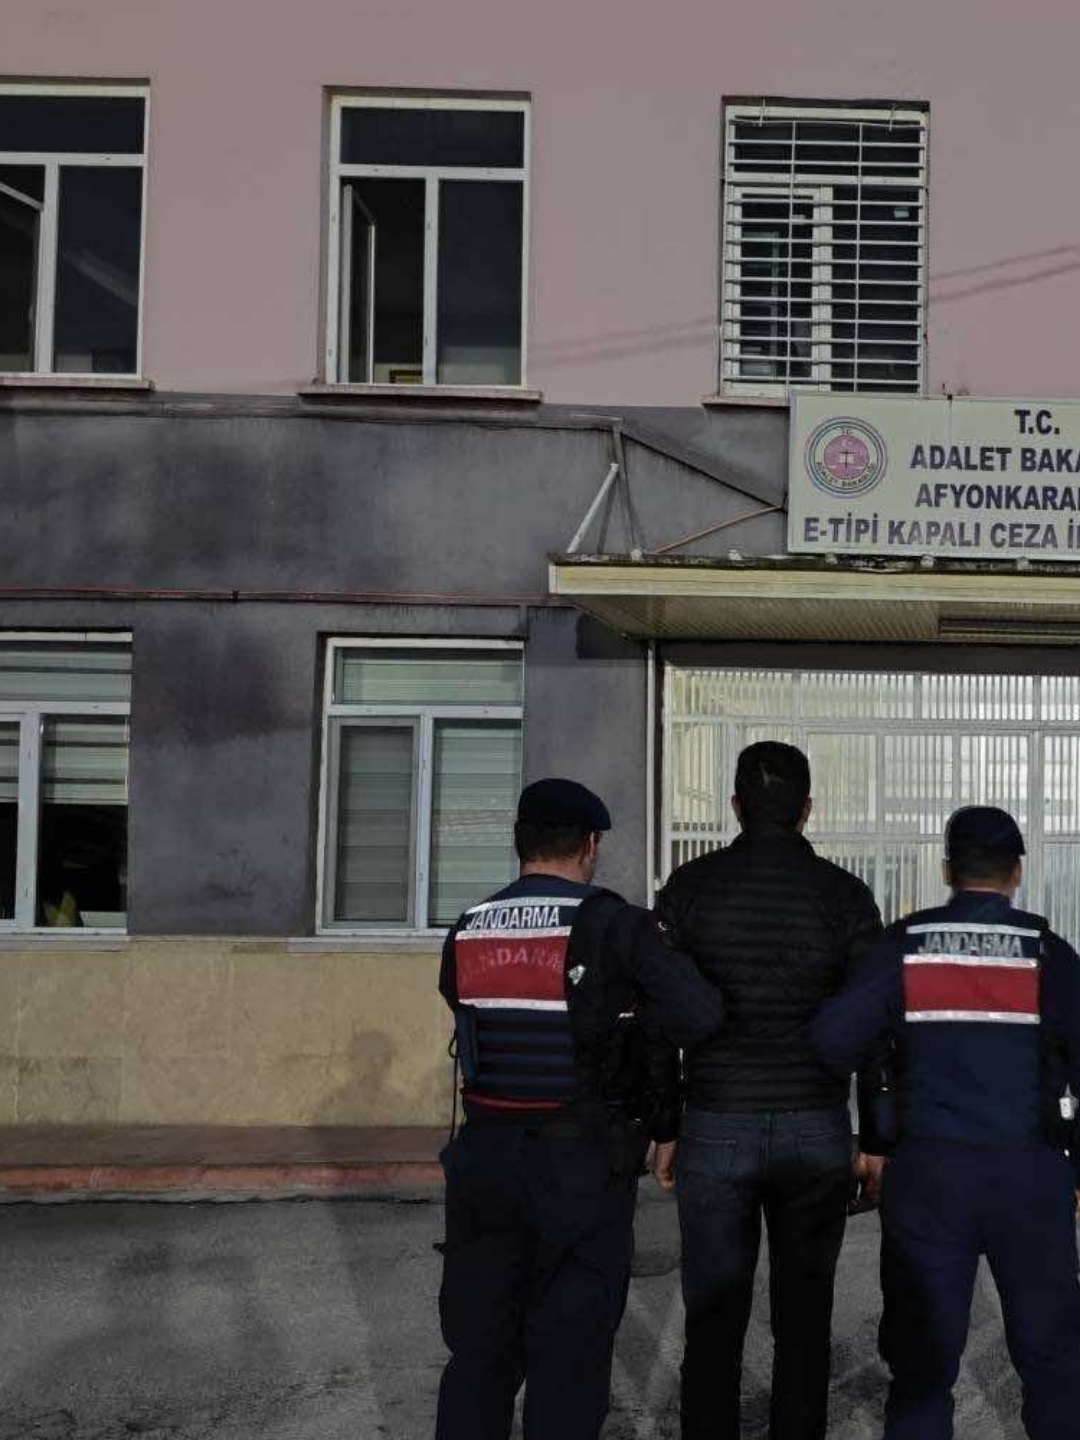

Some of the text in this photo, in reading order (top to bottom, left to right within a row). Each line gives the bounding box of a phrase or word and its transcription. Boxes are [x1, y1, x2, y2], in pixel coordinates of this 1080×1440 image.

[1014, 409, 1061, 435] T.C.
[910, 444, 1012, 472] ADALET
[803, 513, 878, 543] E-TİPİ
[888, 520, 980, 547] KAPALI
[990, 523, 1058, 549] CEZA
[466, 906, 560, 931] JANDARMA
[918, 932, 1023, 957] JANDARMA
